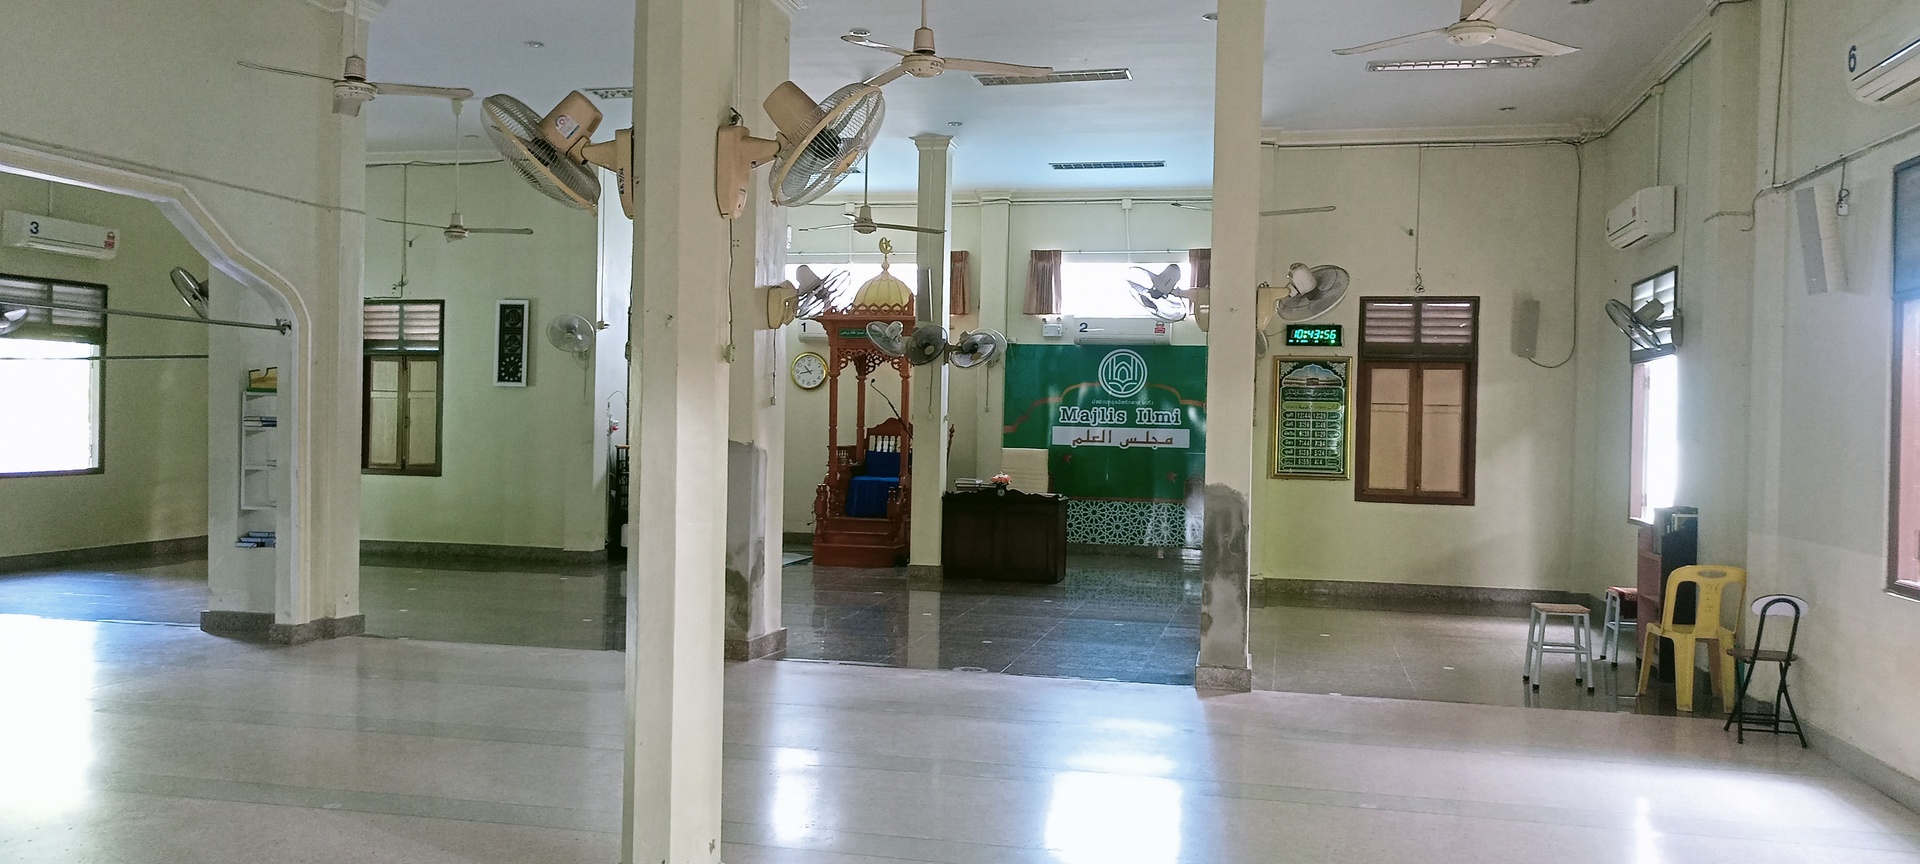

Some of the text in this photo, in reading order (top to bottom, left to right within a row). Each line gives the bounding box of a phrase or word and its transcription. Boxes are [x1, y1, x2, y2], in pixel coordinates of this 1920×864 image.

[1848, 45, 1857, 73] 6
[30, 221, 39, 234] 3
[801, 322, 806, 332] 1
[1079, 322, 1088, 332] 2
[1294, 329, 1337, 340] 10:43:56
[1059, 406, 1181, 426] Majlis Ilmi
[1072, 429, 1173, 448] مجلس العلم
